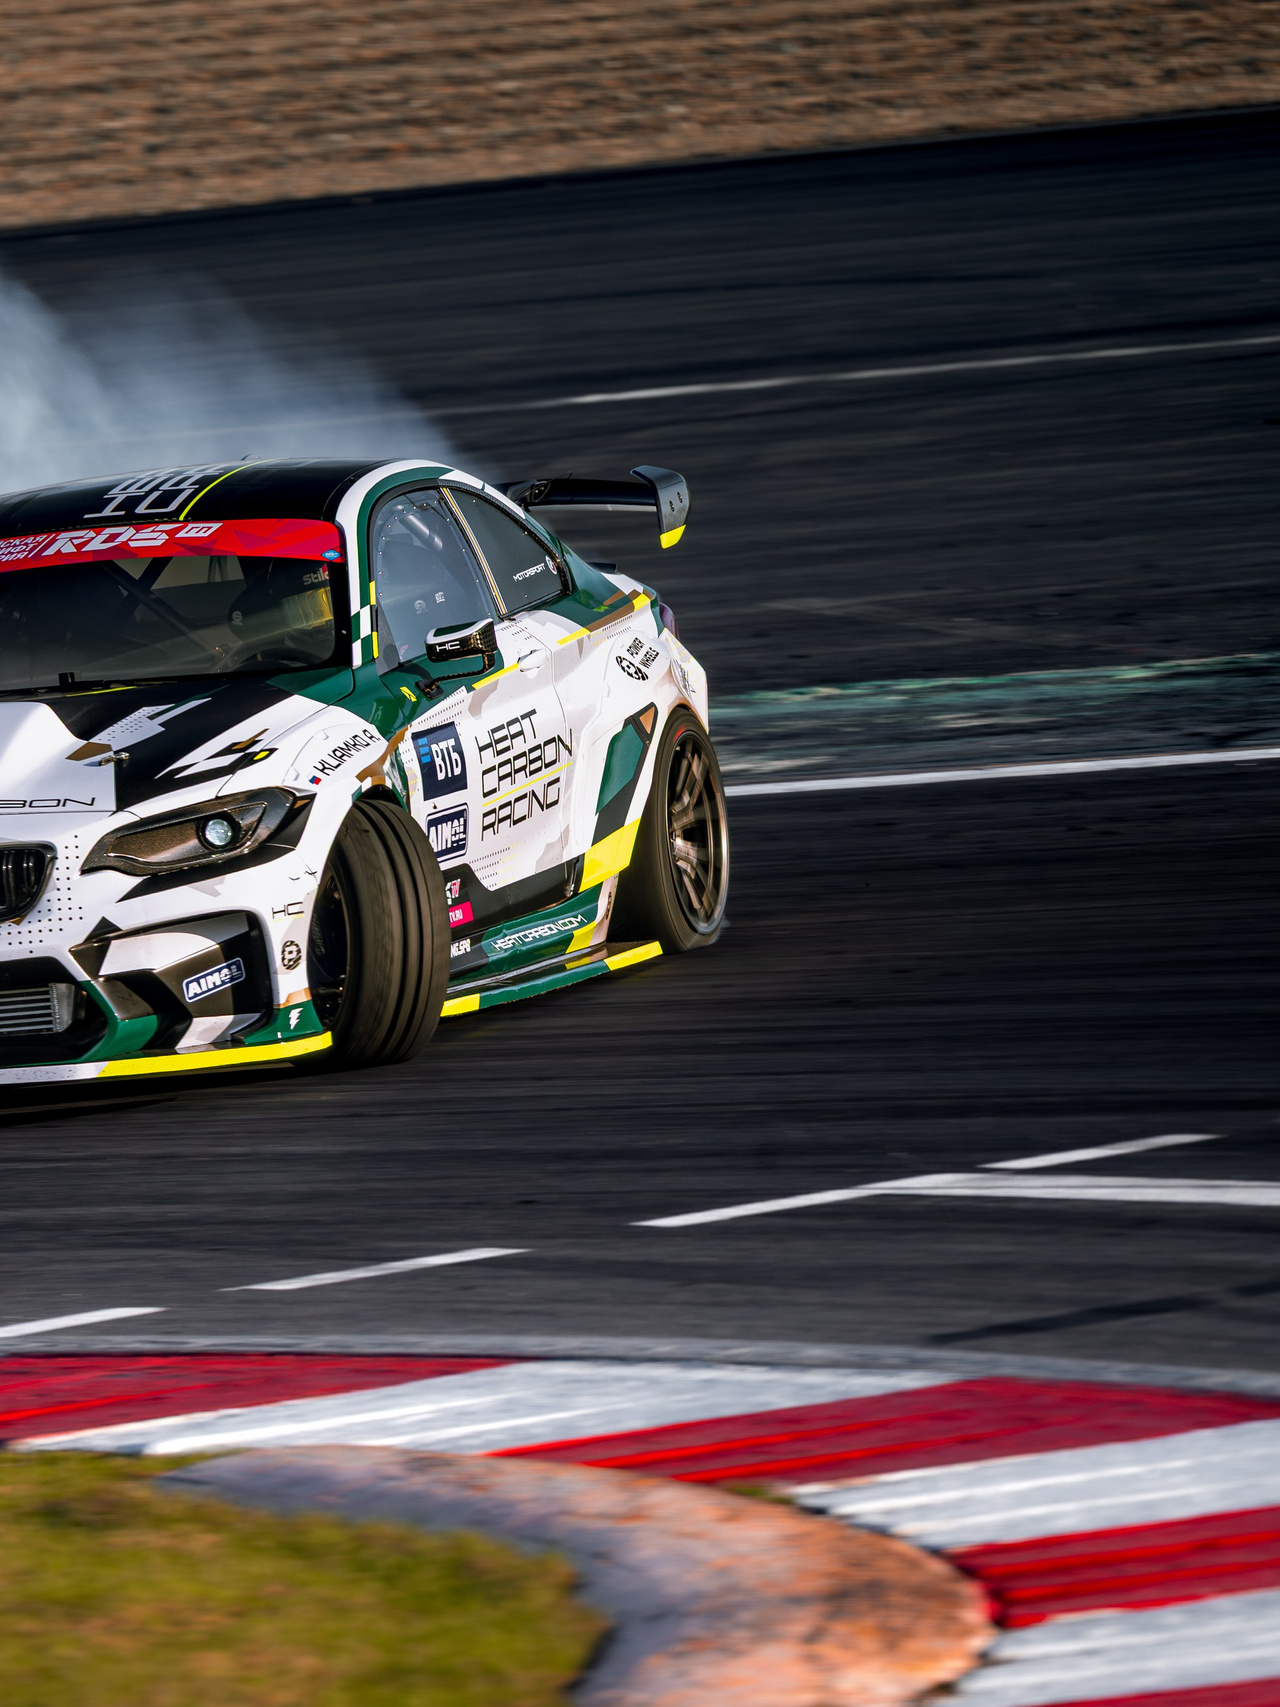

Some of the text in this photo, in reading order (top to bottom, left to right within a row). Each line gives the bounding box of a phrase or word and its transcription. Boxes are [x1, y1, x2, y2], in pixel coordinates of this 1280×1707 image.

[42, 523, 184, 556] RDS
[513, 563, 546, 584] MOTORSPORT
[436, 641, 460, 652] HC
[626, 637, 645, 658] POWER
[639, 647, 660, 669] WHEELS
[475, 708, 537, 764] HEAT
[313, 734, 371, 776] KLIAMKO
[431, 738, 462, 781] ВТБ
[482, 728, 572, 798] CARBON
[481, 776, 560, 841] RACING
[272, 901, 304, 919] HC
[491, 914, 587, 951] HEATCARBON.COM
